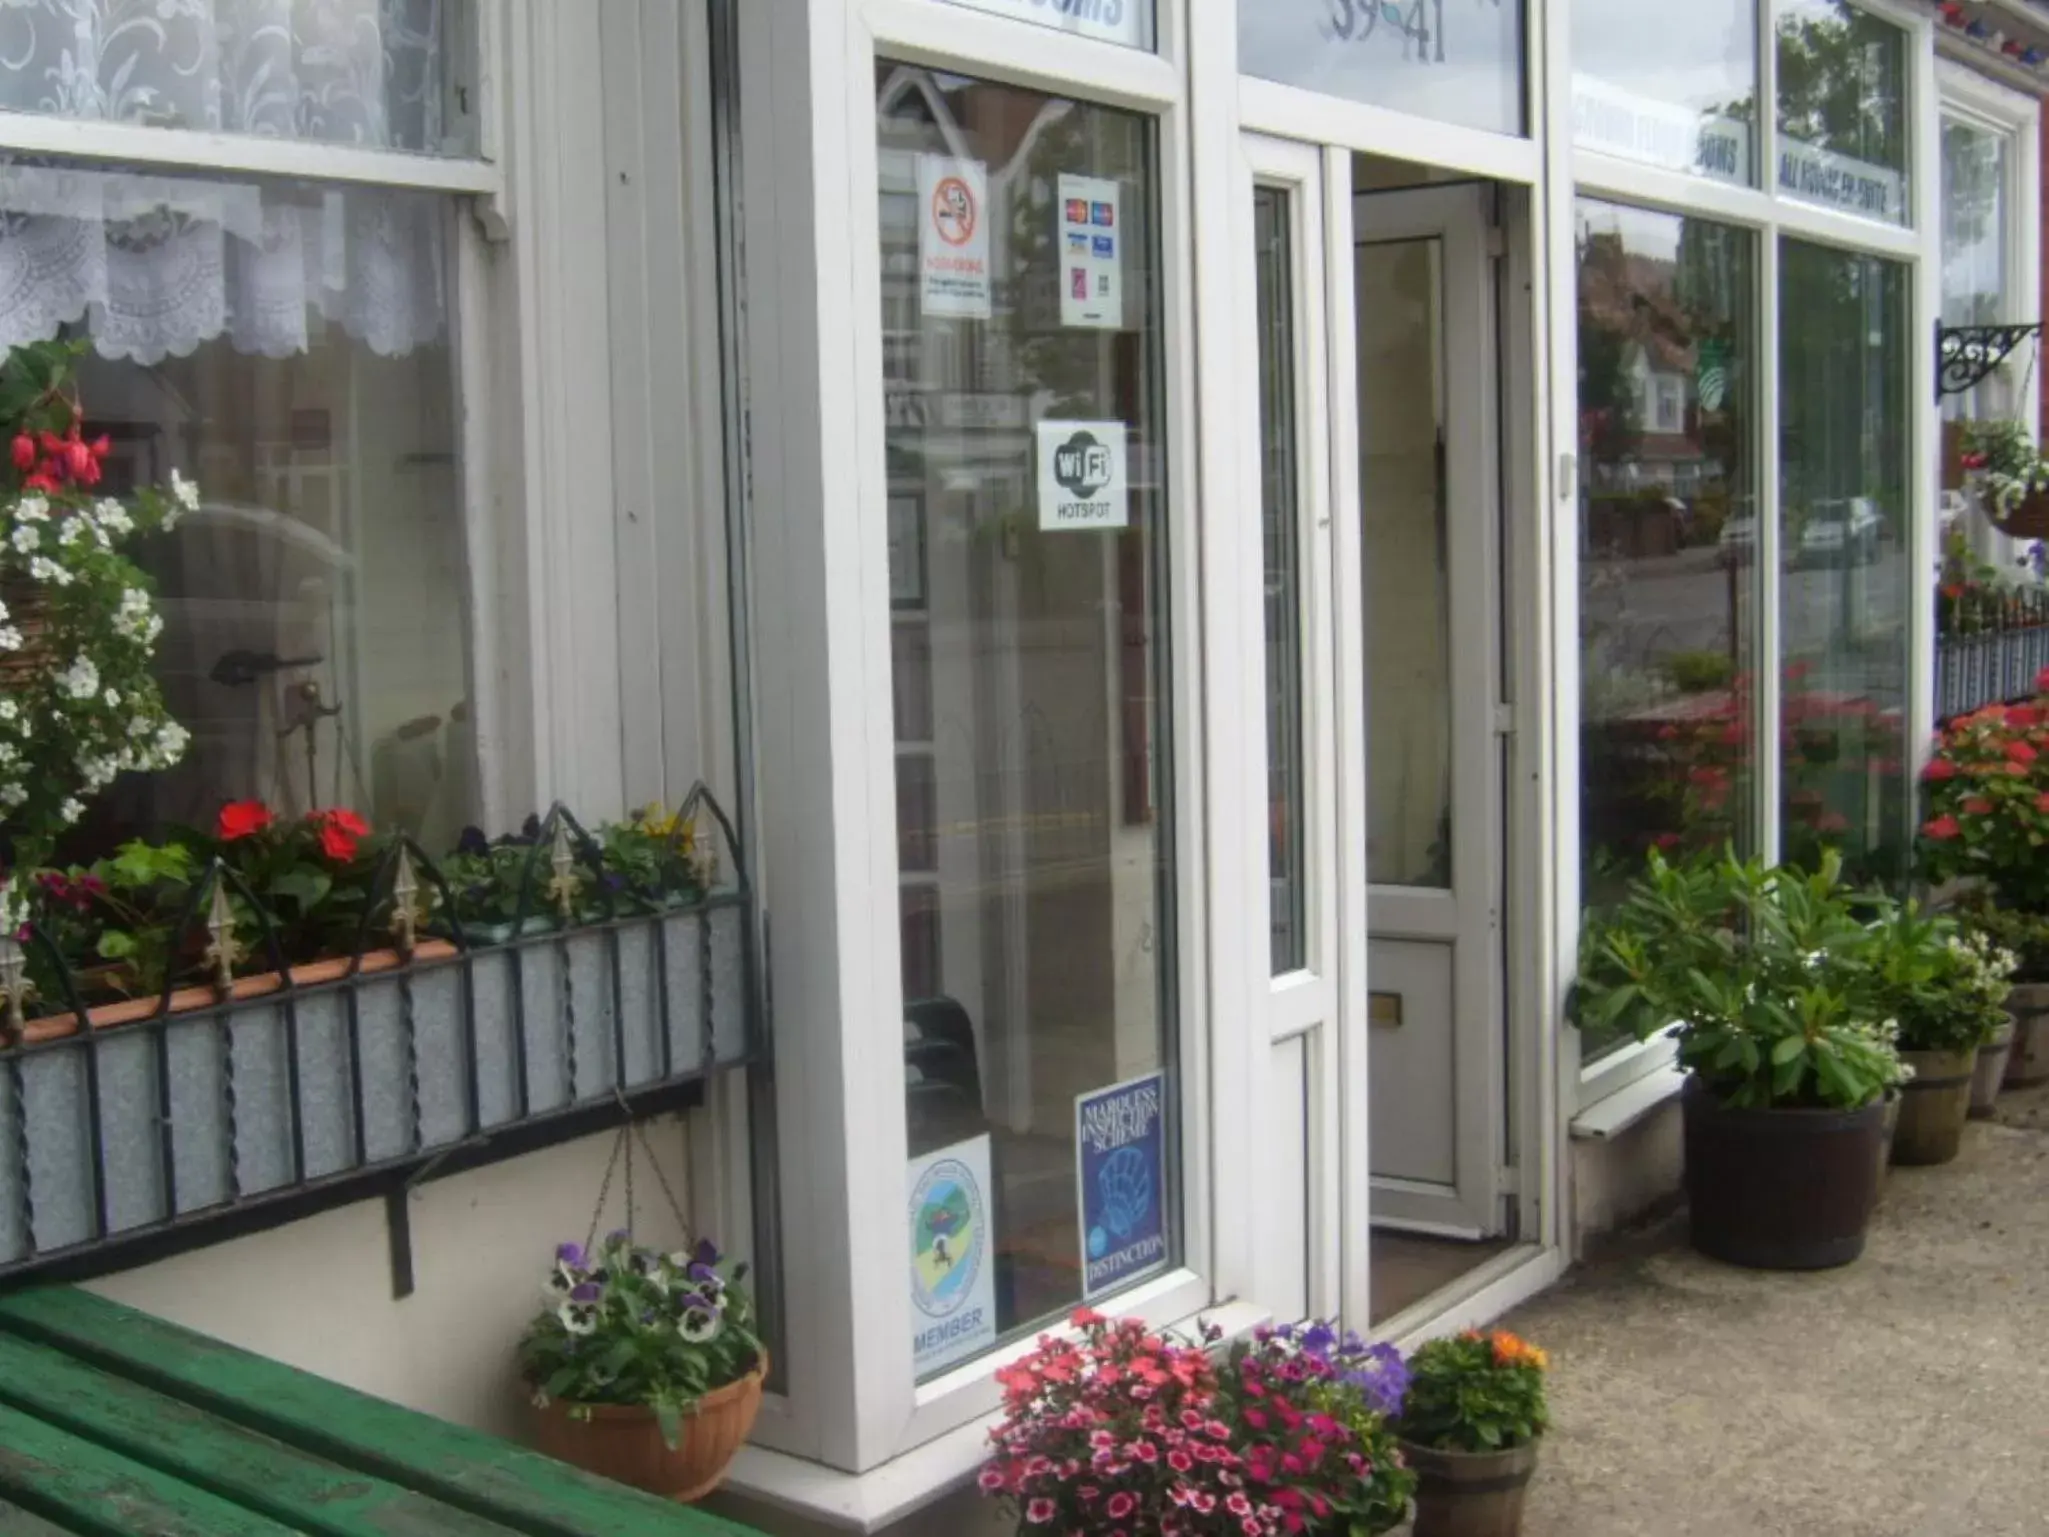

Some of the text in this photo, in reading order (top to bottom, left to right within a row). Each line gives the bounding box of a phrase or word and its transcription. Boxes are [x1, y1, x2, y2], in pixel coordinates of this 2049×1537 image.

[1058, 502, 1110, 519] HOTSPOT
[1087, 1235, 1164, 1284] DISTINCTION
[914, 1308, 984, 1352] MEMBER
